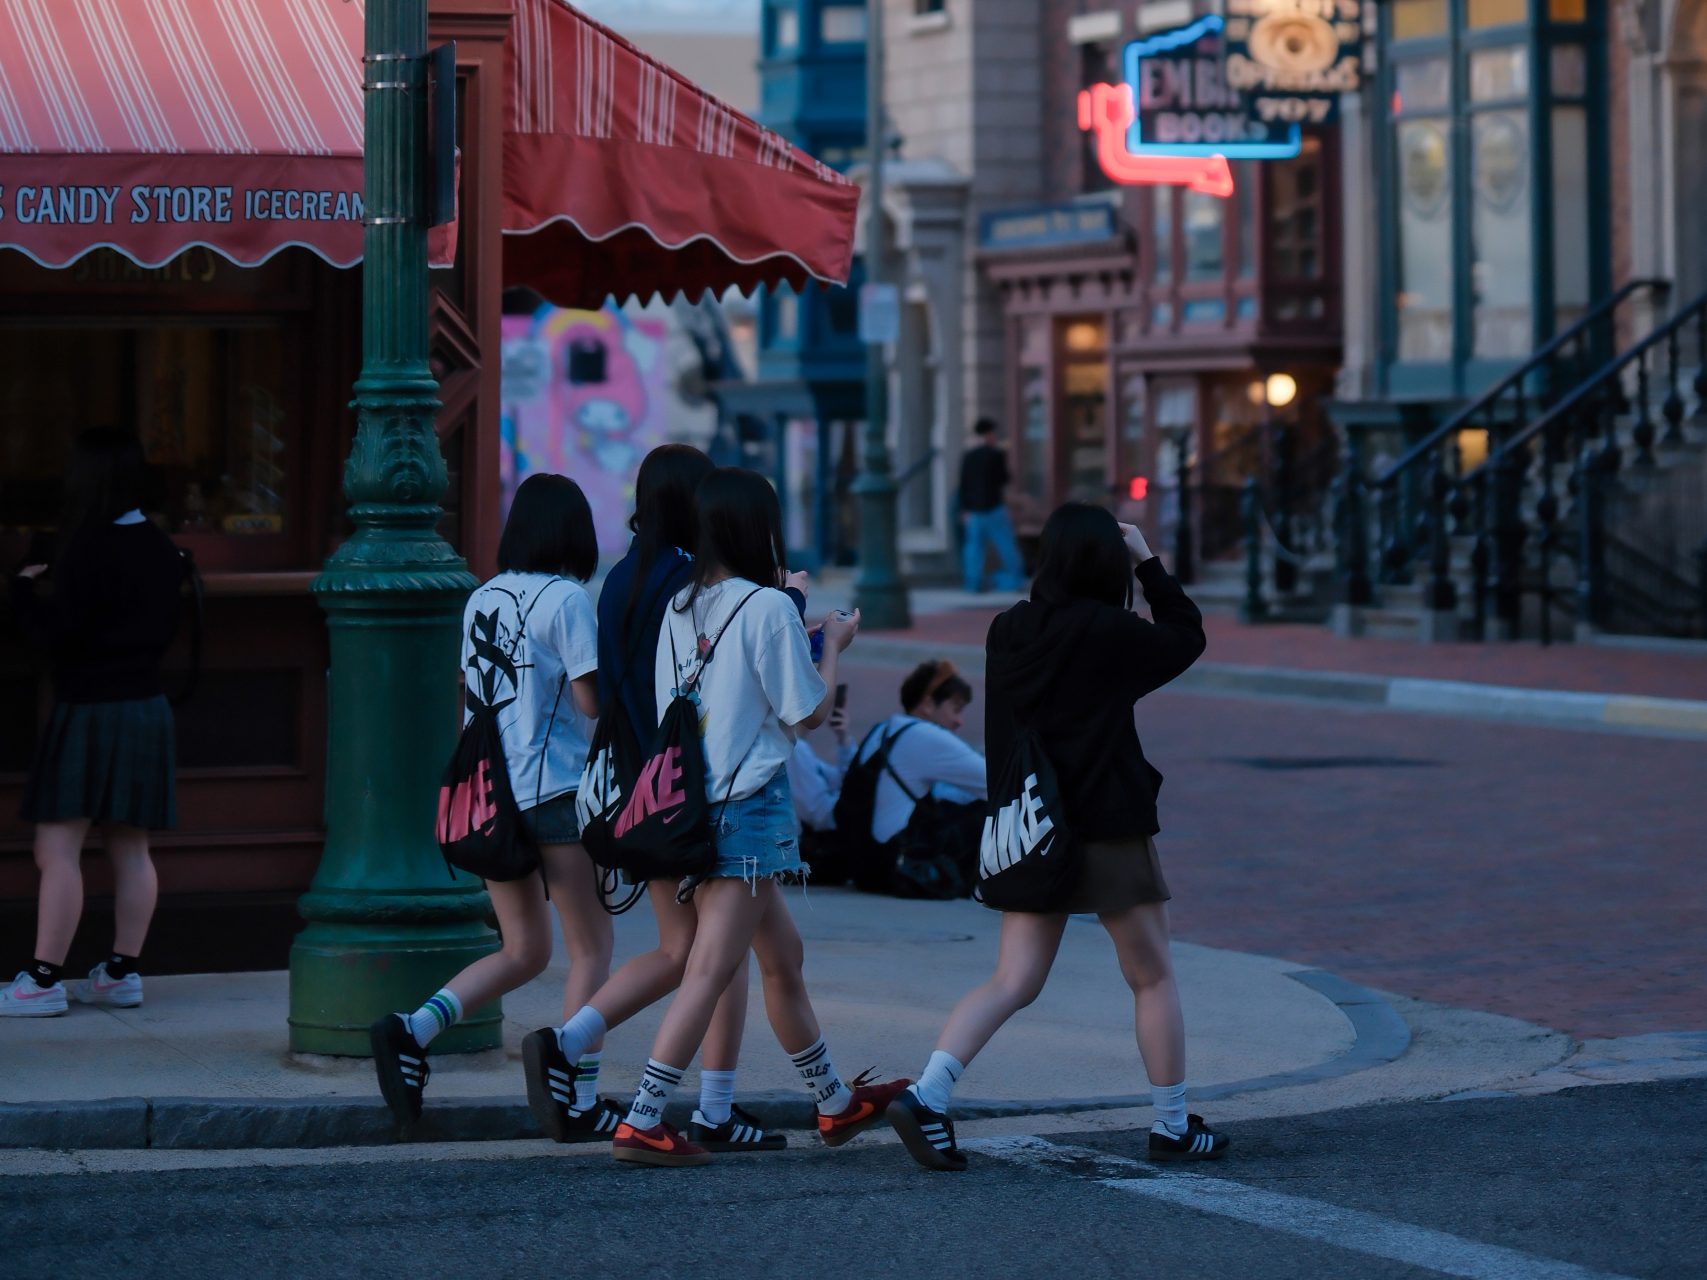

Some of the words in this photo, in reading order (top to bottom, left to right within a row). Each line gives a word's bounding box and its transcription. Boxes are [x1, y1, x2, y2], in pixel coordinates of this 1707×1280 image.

[15, 185, 121, 224] CANDY
[130, 185, 234, 224] STORE
[979, 772, 1055, 881] NIKE
